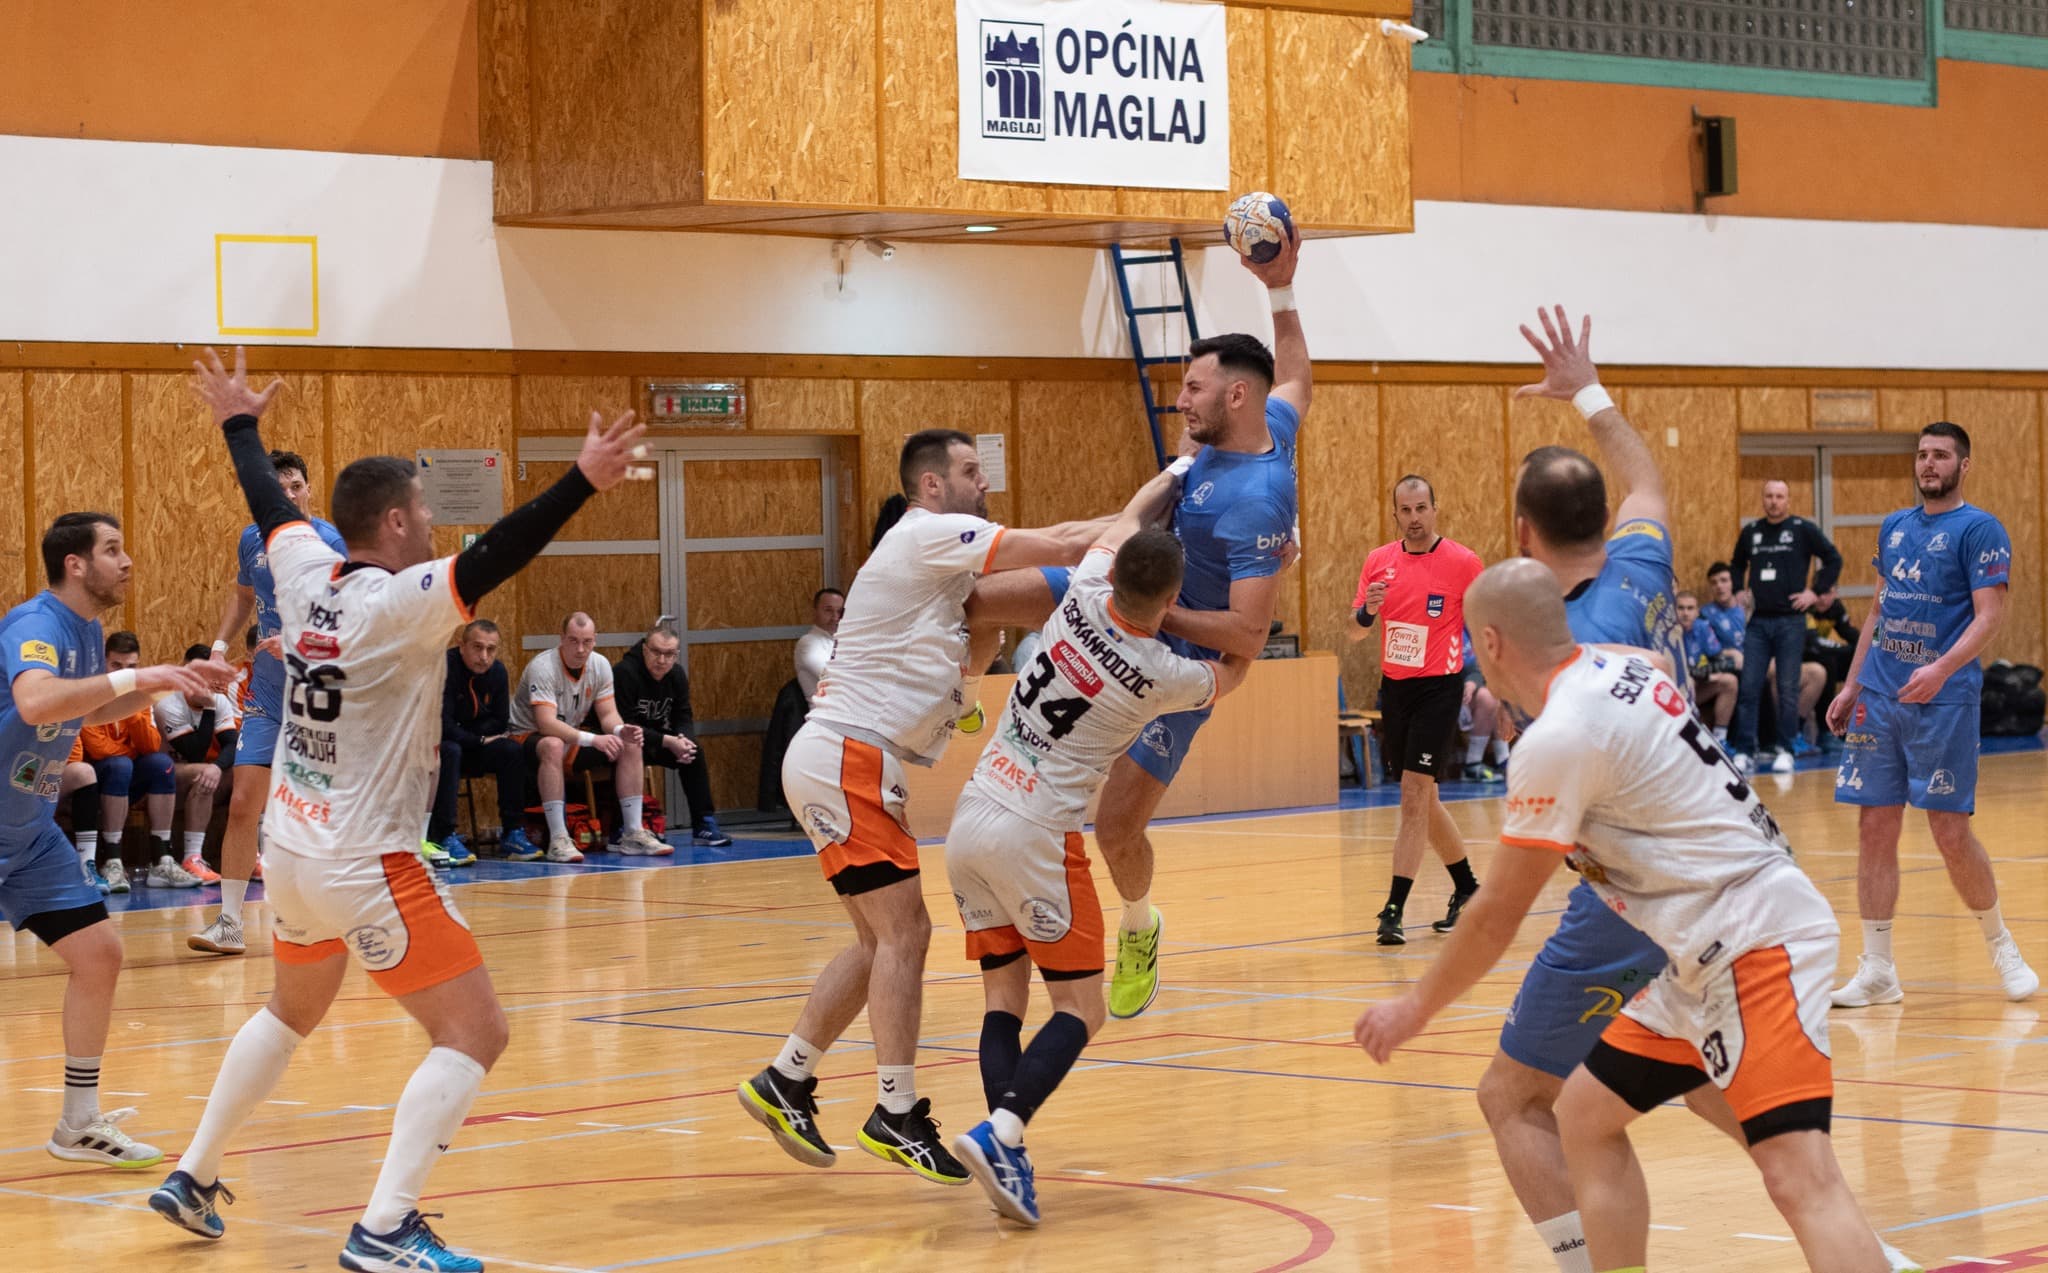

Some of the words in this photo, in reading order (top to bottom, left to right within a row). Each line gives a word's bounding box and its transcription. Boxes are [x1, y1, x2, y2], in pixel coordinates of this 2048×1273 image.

[1055, 19, 1204, 83] OPĆINA
[987, 120, 1041, 134] MAGLAJ
[1054, 90, 1206, 145] MAGLAJ
[687, 398, 723, 412] IZLAZ
[1891, 557, 1922, 583] 44
[1063, 598, 1155, 699] OSMANHODŽIĆ
[284, 652, 347, 723] 26
[1015, 651, 1093, 740] 34
[1836, 765, 1863, 790] 44
[1552, 1238, 1586, 1254] adida
